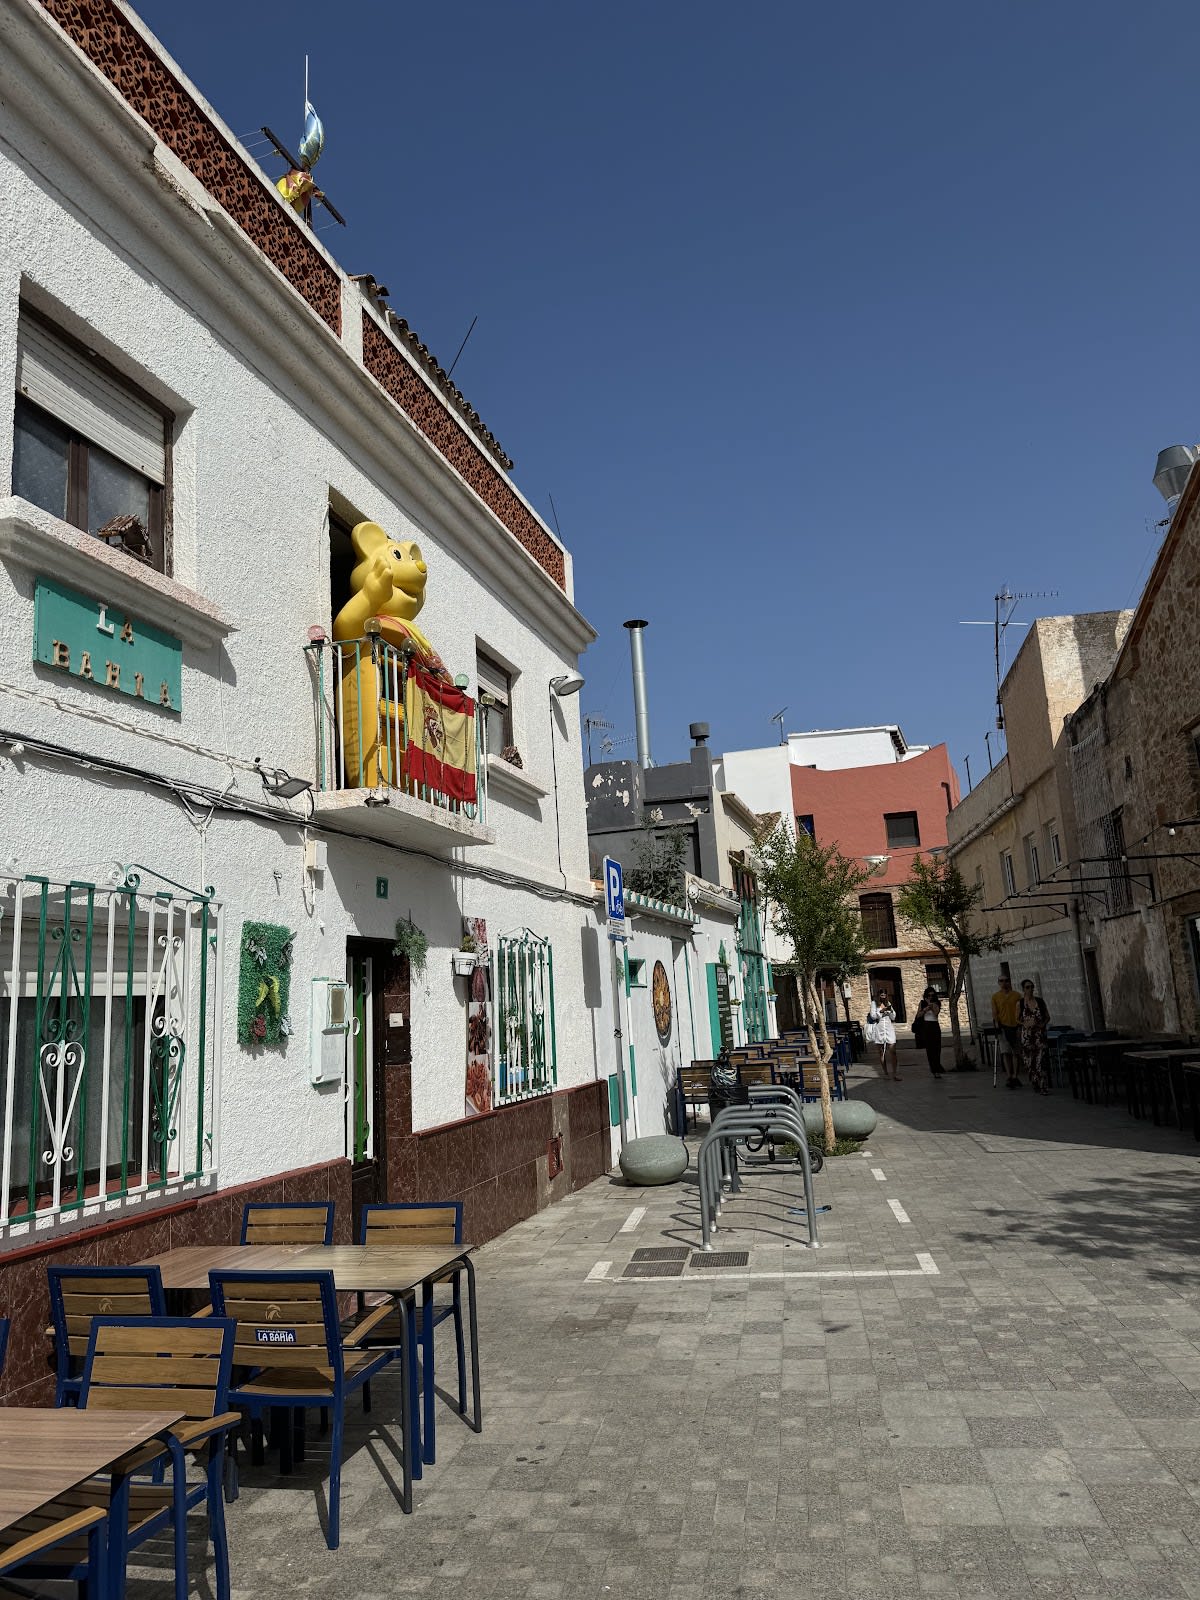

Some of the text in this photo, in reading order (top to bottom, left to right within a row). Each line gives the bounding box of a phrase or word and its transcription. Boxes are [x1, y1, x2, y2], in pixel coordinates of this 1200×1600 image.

[96, 602, 135, 643] LA
[52, 639, 172, 708] BAHIA
[609, 866, 620, 912] P
[258, 1332, 268, 1342] LA
